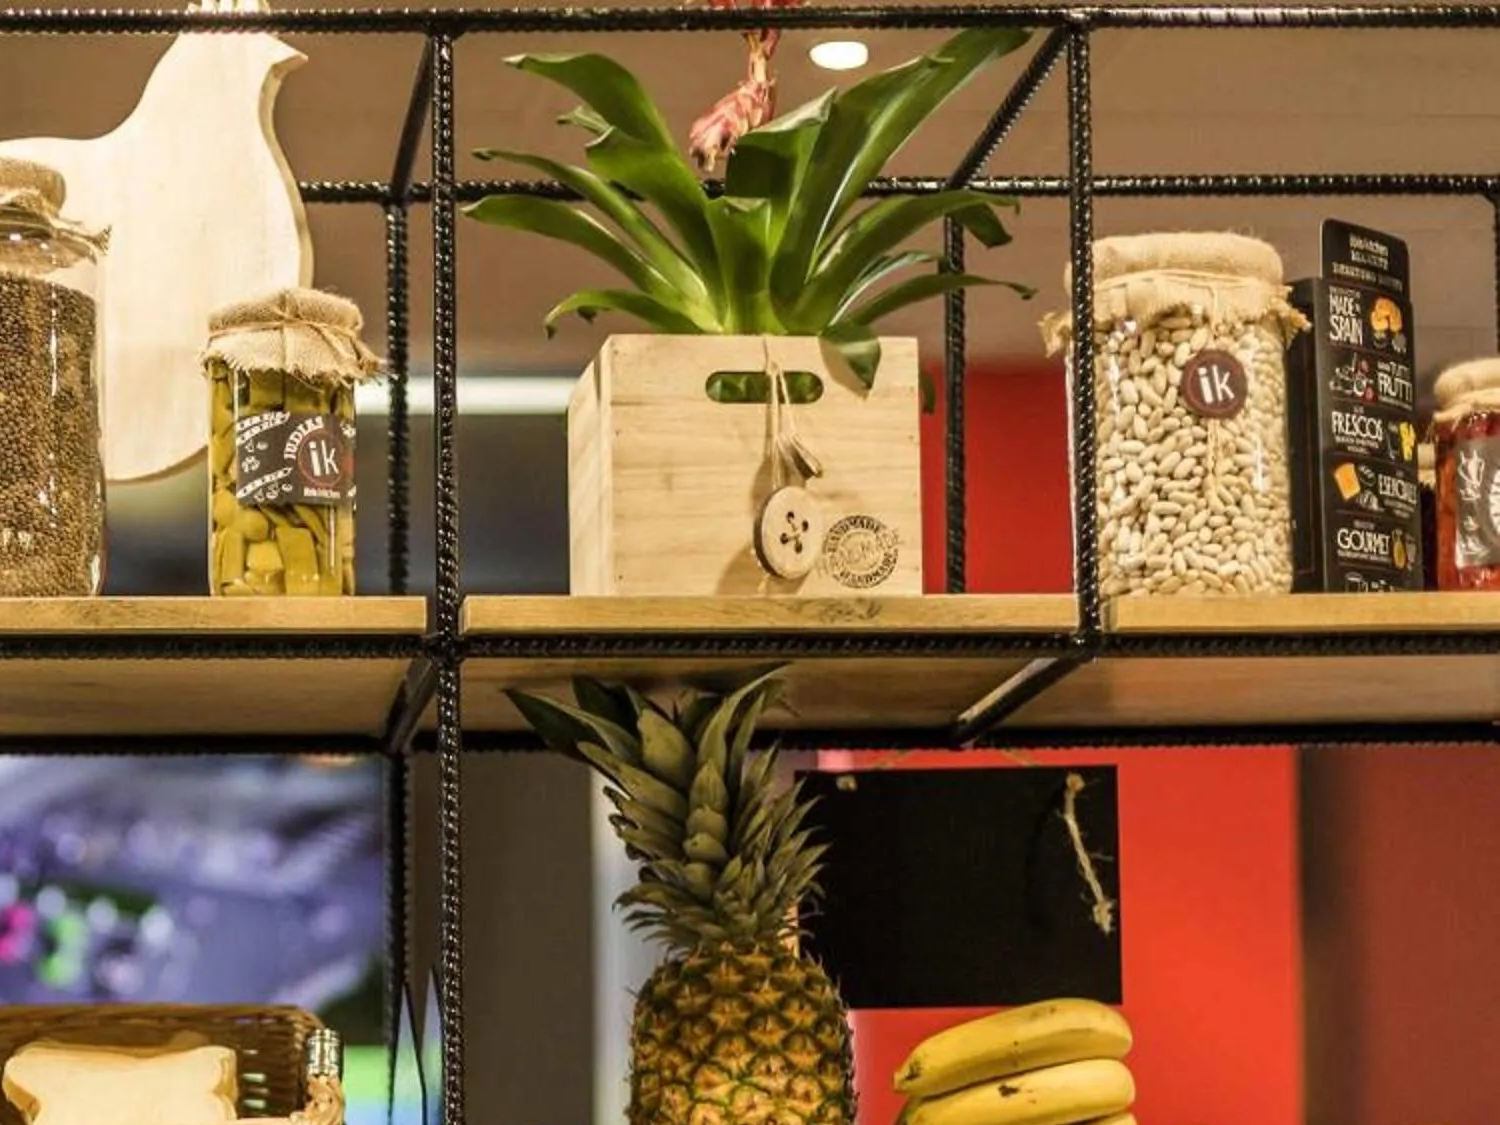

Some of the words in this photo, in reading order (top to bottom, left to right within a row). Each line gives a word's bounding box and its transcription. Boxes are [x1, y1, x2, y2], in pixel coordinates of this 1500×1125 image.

[1329, 315, 1363, 345] SPAIN
[1198, 364, 1235, 404] ik
[1331, 411, 1383, 441] FRESCOS
[309, 440, 339, 477] ik
[1337, 527, 1391, 555] GOURMET
